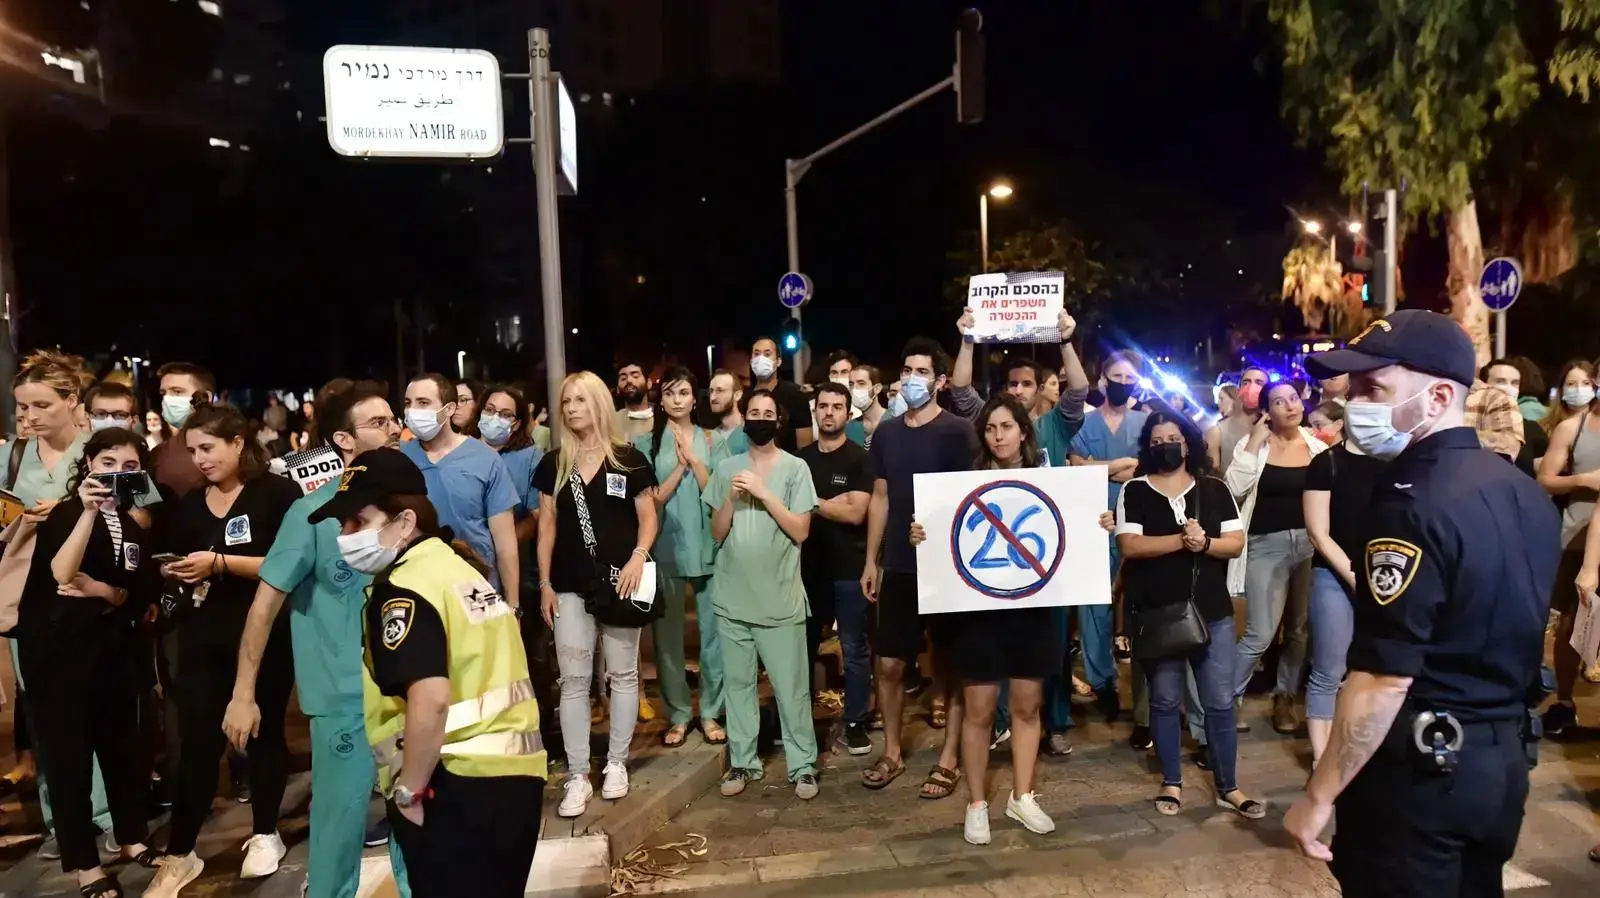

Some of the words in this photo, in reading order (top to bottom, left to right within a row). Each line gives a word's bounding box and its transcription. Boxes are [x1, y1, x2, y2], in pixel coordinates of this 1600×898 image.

[341, 61, 390, 79] נמיר
[398, 68, 448, 81] מרדכי
[456, 70, 483, 85] דרך
[413, 93, 454, 109] طريق
[343, 126, 404, 140] MORDEKHAY
[409, 123, 456, 140] NAMIR
[460, 129, 487, 140] ROAD
[972, 285, 1009, 298] הקרוב
[1013, 284, 1059, 296] בהסכם
[981, 299, 997, 308] את
[1001, 298, 1046, 308] משפרים
[989, 312, 1037, 321] ההכשרה
[230, 519, 245, 535] 26
[966, 502, 1046, 570] 26
